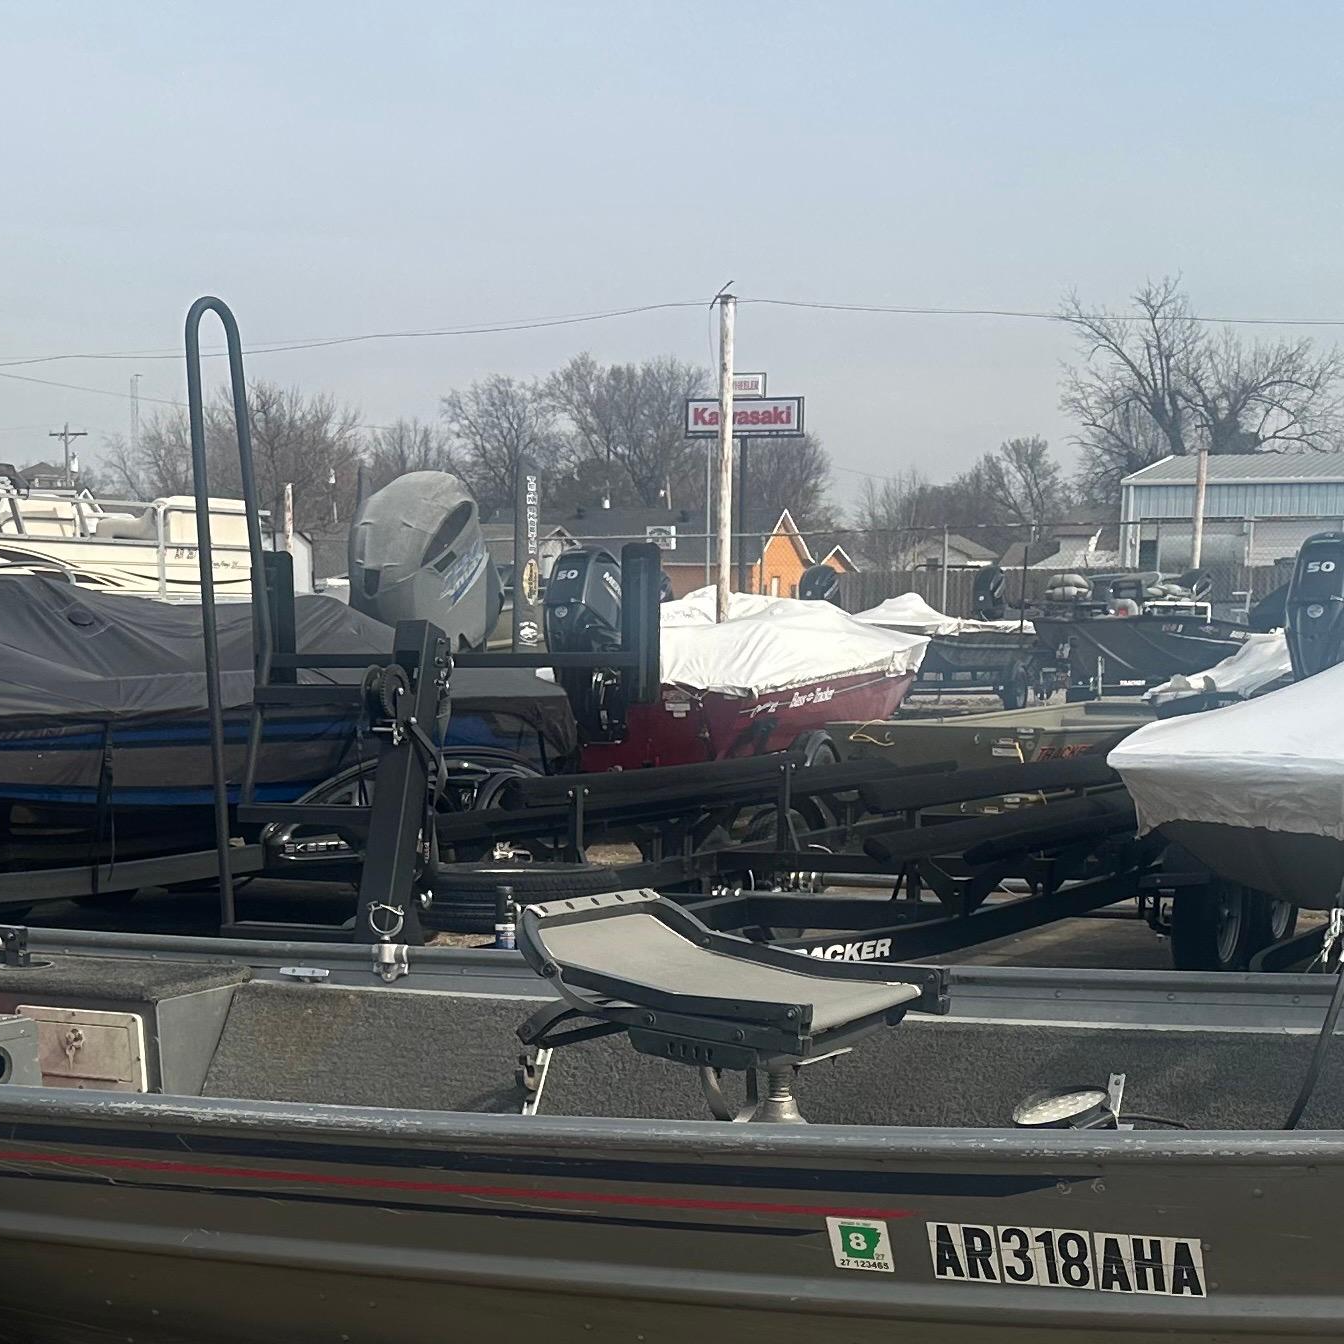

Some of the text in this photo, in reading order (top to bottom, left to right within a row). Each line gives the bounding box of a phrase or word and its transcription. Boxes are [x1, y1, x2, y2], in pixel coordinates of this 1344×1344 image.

[1307, 561, 1336, 573] 50
[557, 569, 578, 581] 50
[849, 1232, 868, 1251] 8
[840, 1258, 851, 1266] 27
